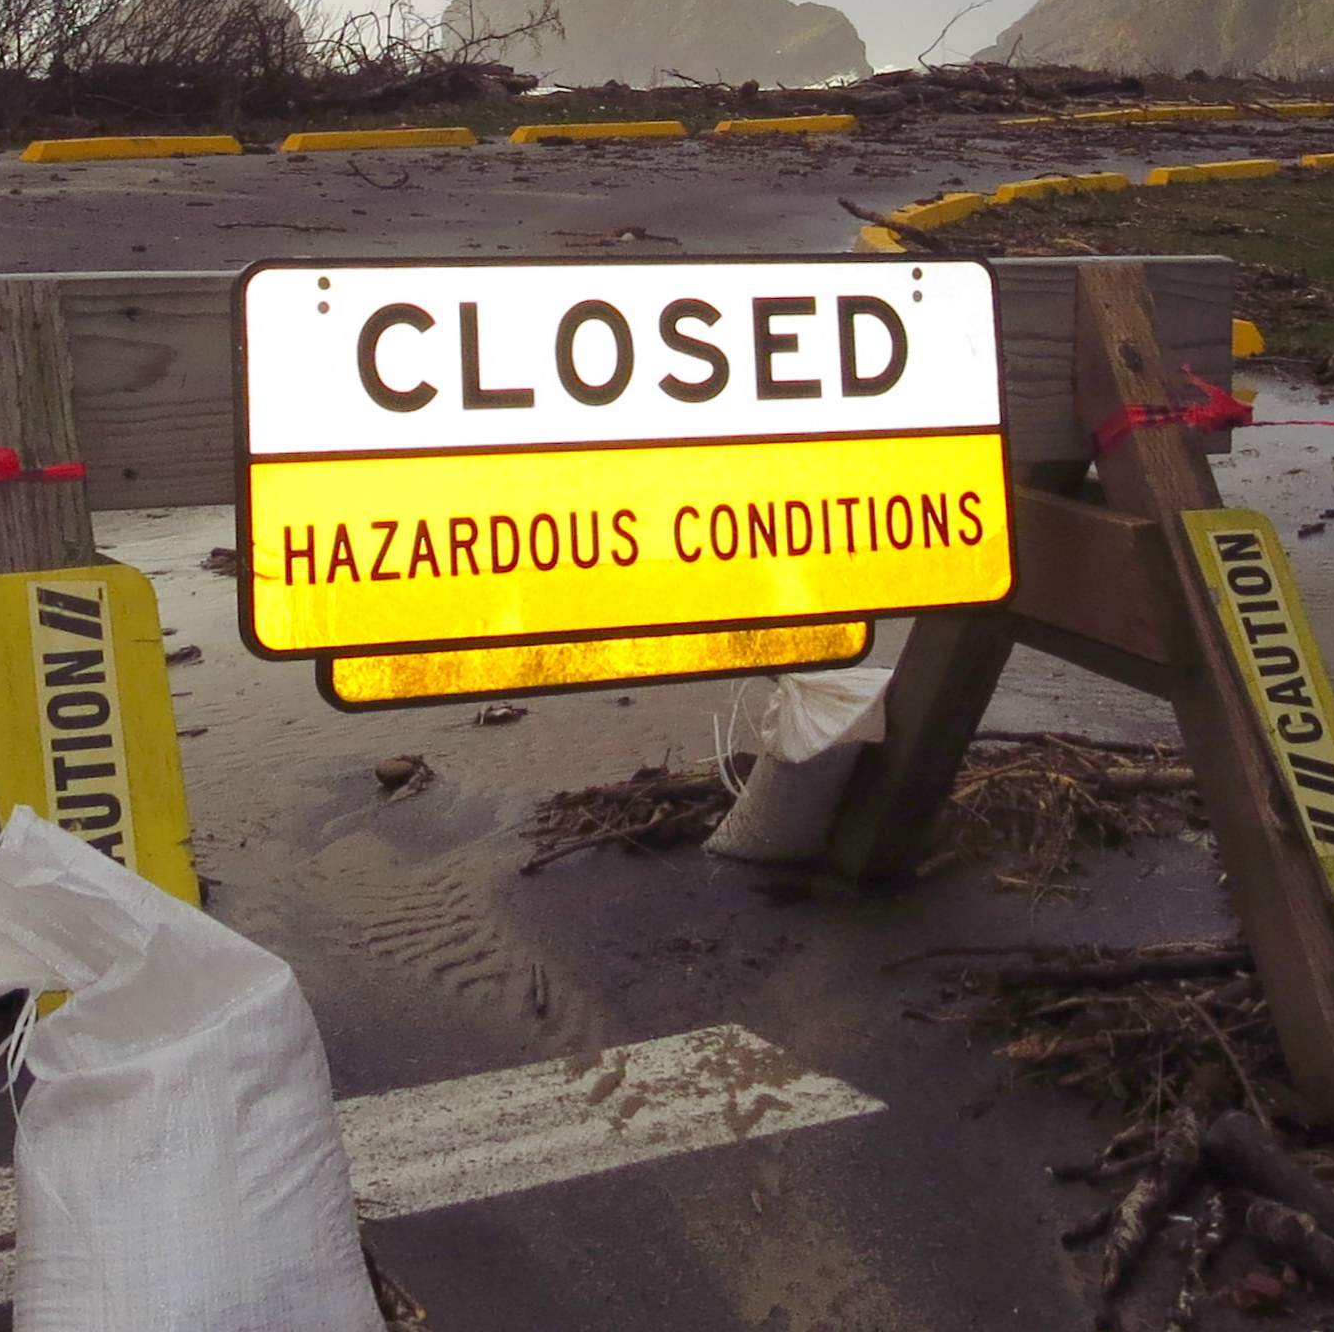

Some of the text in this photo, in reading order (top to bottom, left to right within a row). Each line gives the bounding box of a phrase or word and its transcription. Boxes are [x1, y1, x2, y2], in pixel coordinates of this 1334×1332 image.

[357, 295, 908, 413] CLOSED
[283, 491, 984, 586] HAZARDOUS CONDITIONS
[1213, 533, 1323, 745] CAUTION
